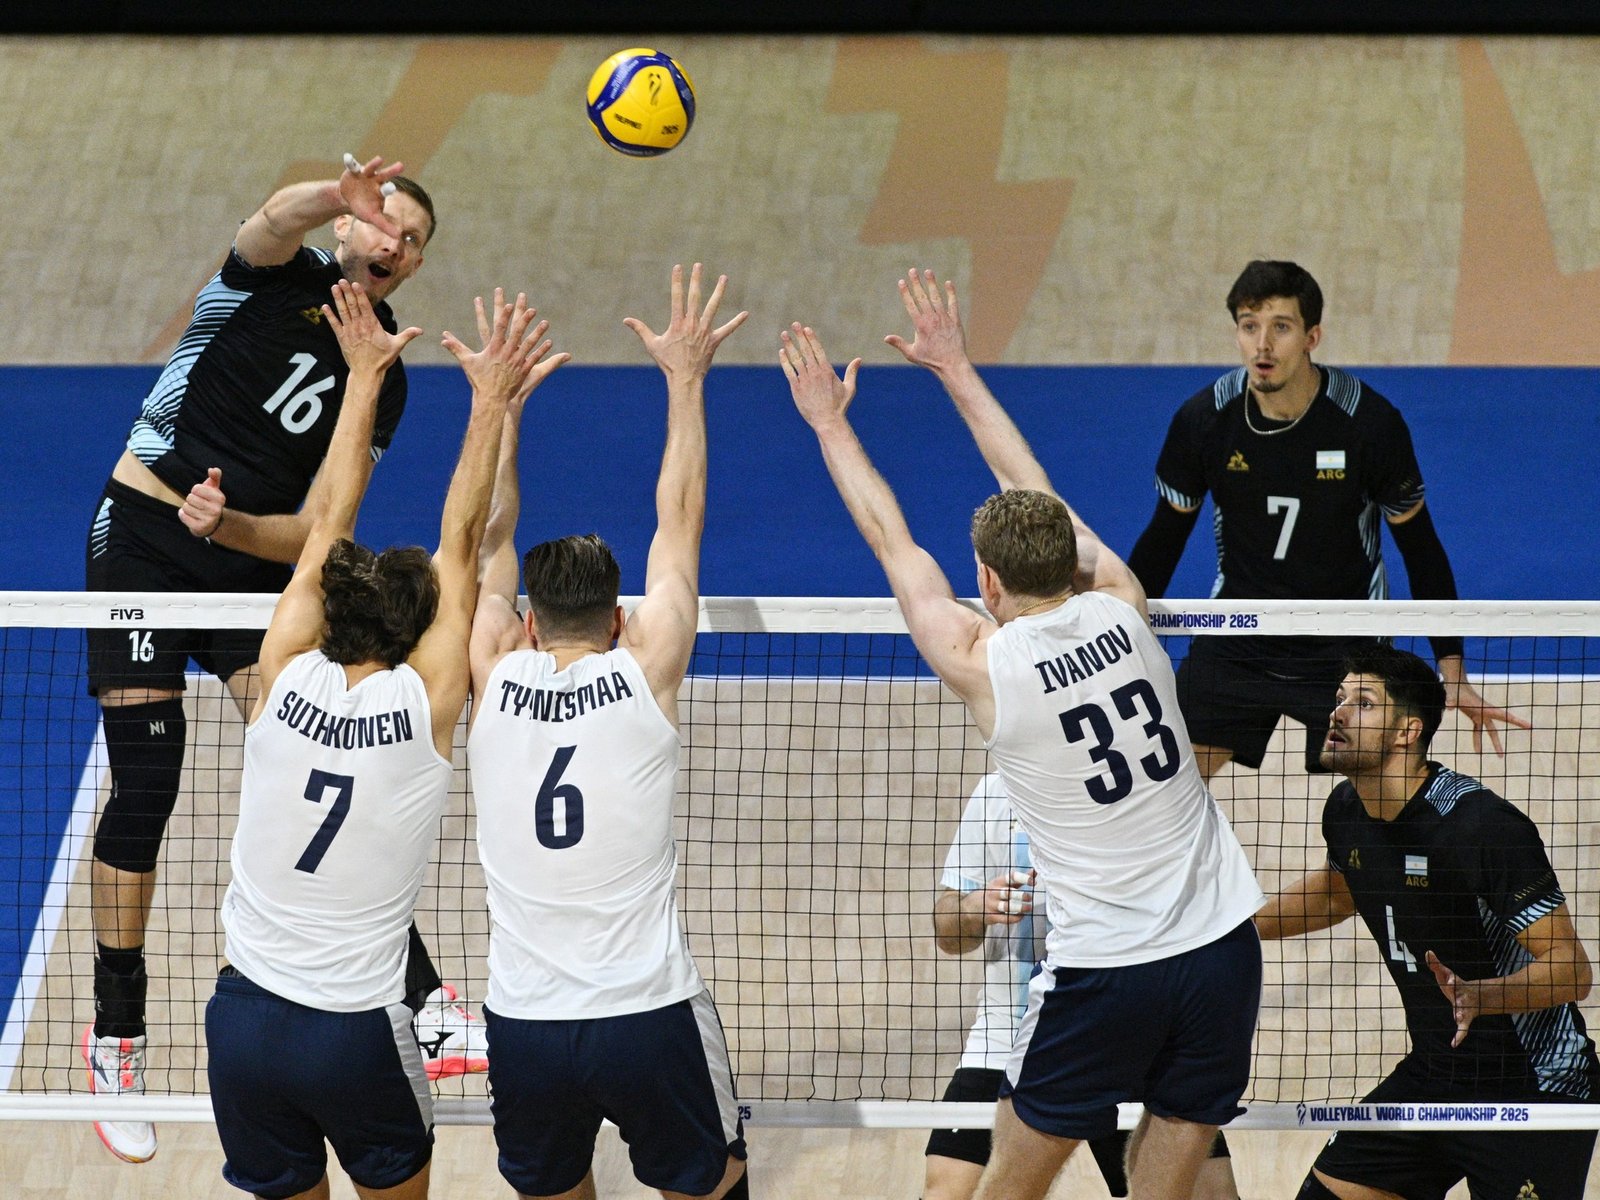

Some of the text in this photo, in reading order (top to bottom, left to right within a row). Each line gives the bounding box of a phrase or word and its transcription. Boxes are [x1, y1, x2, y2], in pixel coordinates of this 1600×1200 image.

[262, 352, 336, 434] 16
[1316, 469, 1345, 480] ARG
[1267, 495, 1300, 560] 7
[110, 608, 144, 620] FIVB
[1229, 614, 1258, 628] 2025
[128, 630, 155, 662] 16
[1034, 624, 1133, 694] IVANOV
[277, 690, 413, 750] SUIHKONEN
[1058, 678, 1181, 804] 33
[294, 768, 354, 874] 7
[535, 745, 584, 849] 6
[1405, 875, 1429, 887] ARG
[1385, 904, 1417, 972] 4
[1310, 1106, 1529, 1121] VOLLEYBALL WORLD CHAMPIONSHIP 2025
